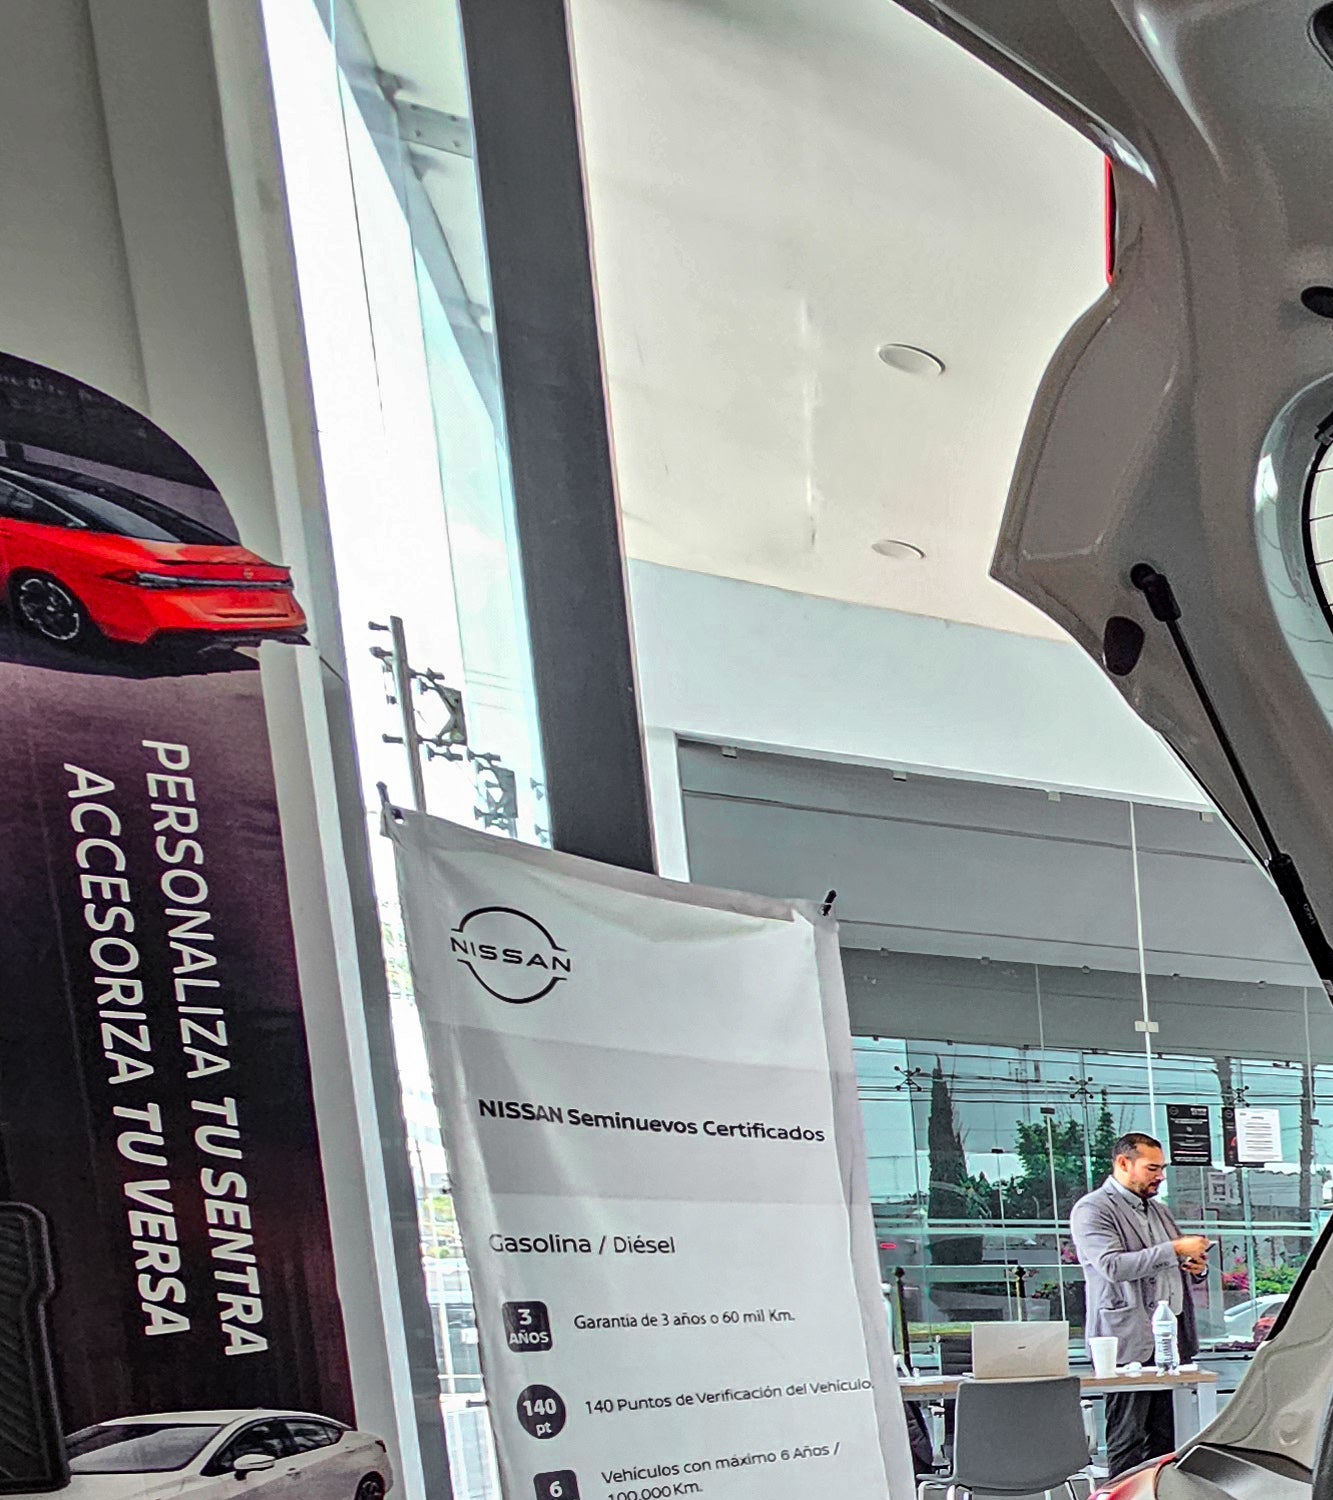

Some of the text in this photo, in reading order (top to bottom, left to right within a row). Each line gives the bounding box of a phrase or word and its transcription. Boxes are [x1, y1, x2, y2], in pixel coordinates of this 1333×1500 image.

[450, 937, 571, 972] NISSAN
[63, 763, 191, 1336] ACCESORIZA TU VERSA
[141, 739, 268, 1356] PERSONALIZA TU SENTRA
[478, 1099, 825, 1142] NISSAN Seminuevos Certificados
[489, 1234, 676, 1255] Gasolina / Diésel
[518, 1309, 532, 1325] 3
[641, 1313, 658, 1326] de
[661, 1314, 669, 1326] 3
[673, 1313, 706, 1325] años
[711, 1314, 719, 1324] o
[722, 1311, 739, 1324] 60
[743, 1309, 765, 1322] mil
[769, 1309, 795, 1322] Km.
[509, 1329, 549, 1344] AÑOS
[523, 1399, 557, 1416] 140
[585, 1400, 614, 1414] 140
[618, 1397, 672, 1411] Puntos
[676, 1394, 694, 1406] de
[695, 1385, 782, 1404] Verificación
[786, 1383, 807, 1396] del
[536, 1422, 552, 1436] pt
[601, 1464, 680, 1484] Vehículos
[684, 1460, 711, 1473] con
[780, 1449, 790, 1460] 6
[793, 1445, 830, 1459] Años
[549, 1480, 563, 1498] 6
[673, 1482, 703, 1496] Km.
